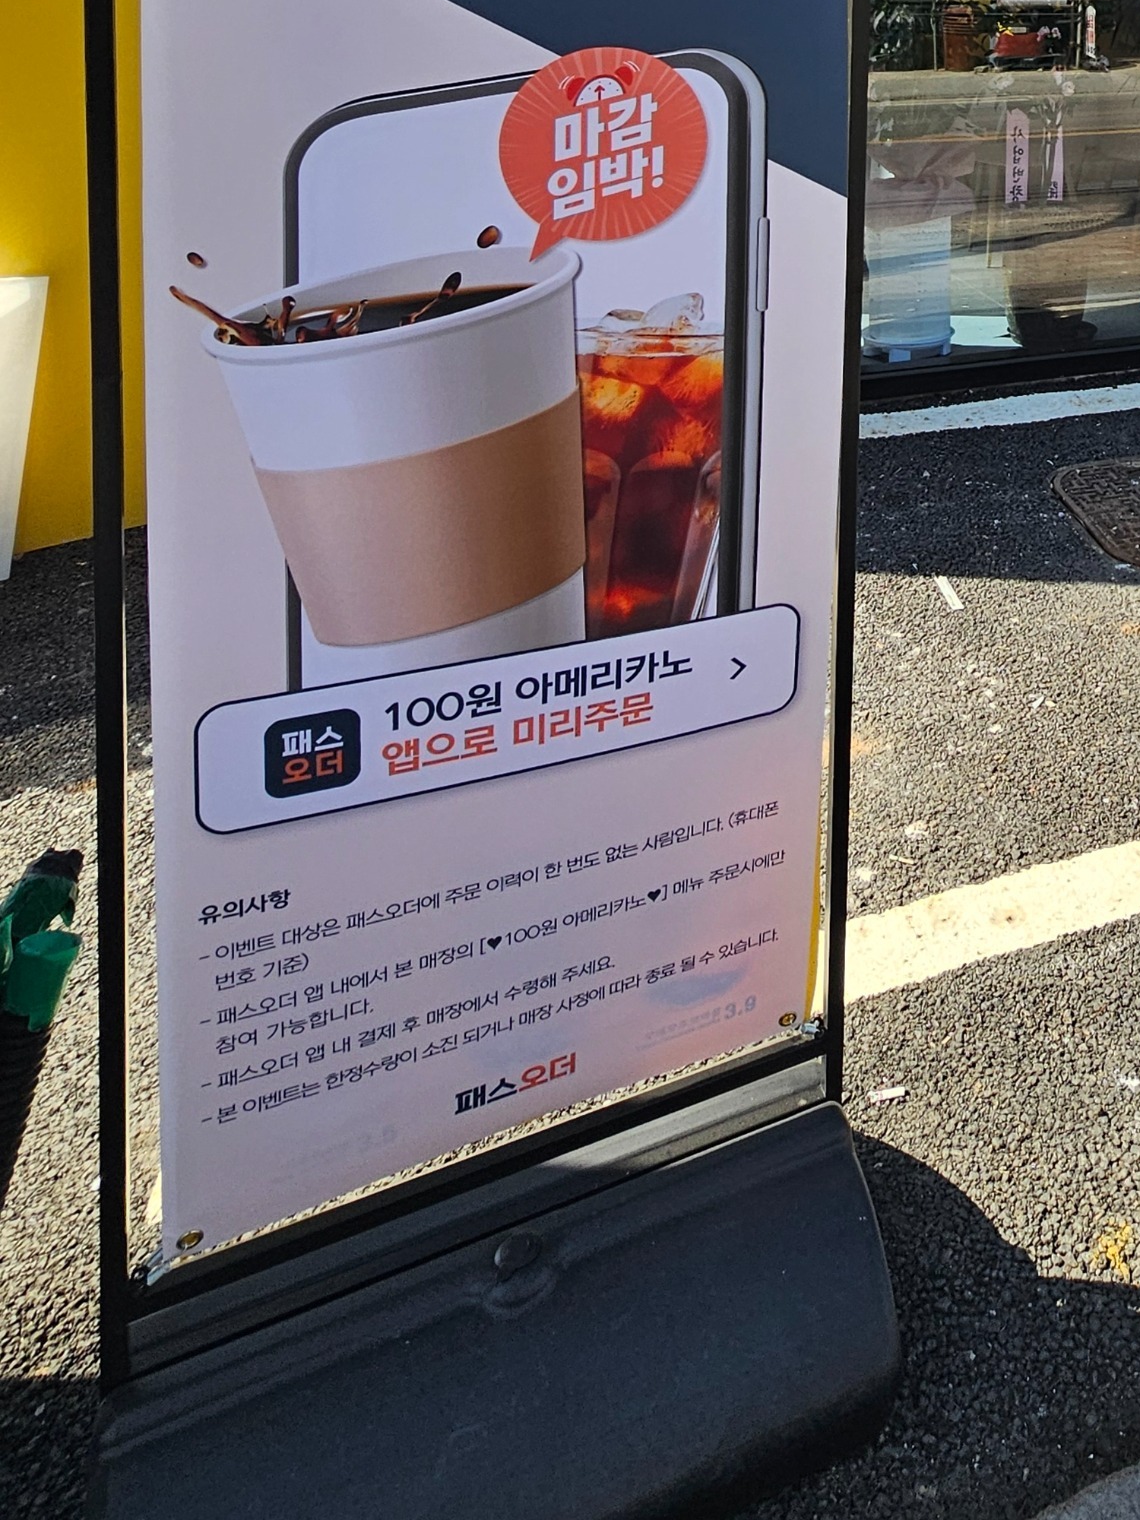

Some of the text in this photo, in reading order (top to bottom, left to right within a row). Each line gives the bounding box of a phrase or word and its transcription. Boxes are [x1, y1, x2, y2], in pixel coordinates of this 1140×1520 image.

[554, 92, 658, 162] 마감
[547, 145, 664, 221] 임박!
[384, 650, 694, 731] 100원 아메리카노
[281, 725, 344, 758] 패스
[282, 754, 343, 784] 오더
[381, 691, 655, 777] 앱으로 미리주문
[198, 889, 291, 926] 유의사항
[214, 933, 276, 962] 이벤트
[282, 918, 341, 946] 대상은
[346, 893, 440, 930] 패스오더에
[445, 883, 482, 905] 주문
[486, 867, 539, 892] 이력이
[543, 861, 562, 879] 한
[567, 851, 601, 873] 번도
[605, 843, 639, 864] 없는
[641, 817, 724, 852] 사람입니다.
[728, 801, 780, 829] (휴대폰
[215, 952, 310, 992] 번호 기준)
[216, 991, 298, 1025] 패스오더
[304, 983, 324, 1003] 앱
[330, 966, 388, 994] 내에서
[394, 960, 413, 979] 본
[419, 942, 474, 970] 매장의
[673, 877, 704, 895] 메뉴
[709, 850, 786, 884] 주문시에만
[215, 998, 374, 1055] 참여 가능합니다.
[216, 1103, 238, 1124] 본
[242, 1081, 321, 1113] 이벤트는
[325, 1047, 417, 1090] 한정수량이
[421, 1034, 459, 1059] 소진
[462, 1016, 515, 1046] 되거나
[519, 1004, 553, 1026] 매장
[556, 987, 605, 1015] 사정에
[609, 974, 641, 996] 따라
[644, 963, 677, 985] 종료
[699, 950, 716, 966] 수
[718, 928, 779, 961] 있습니다.
[217, 1052, 298, 1088] 패스오더
[305, 1044, 326, 1064] 앱
[332, 1033, 351, 1053] 내
[357, 1023, 396, 1048] 결제
[401, 1016, 421, 1034] 후
[426, 991, 498, 1025] 매장에서
[504, 973, 557, 1002] 수령해
[561, 956, 616, 982] 주세요.
[455, 1052, 577, 1116] 패스오더
